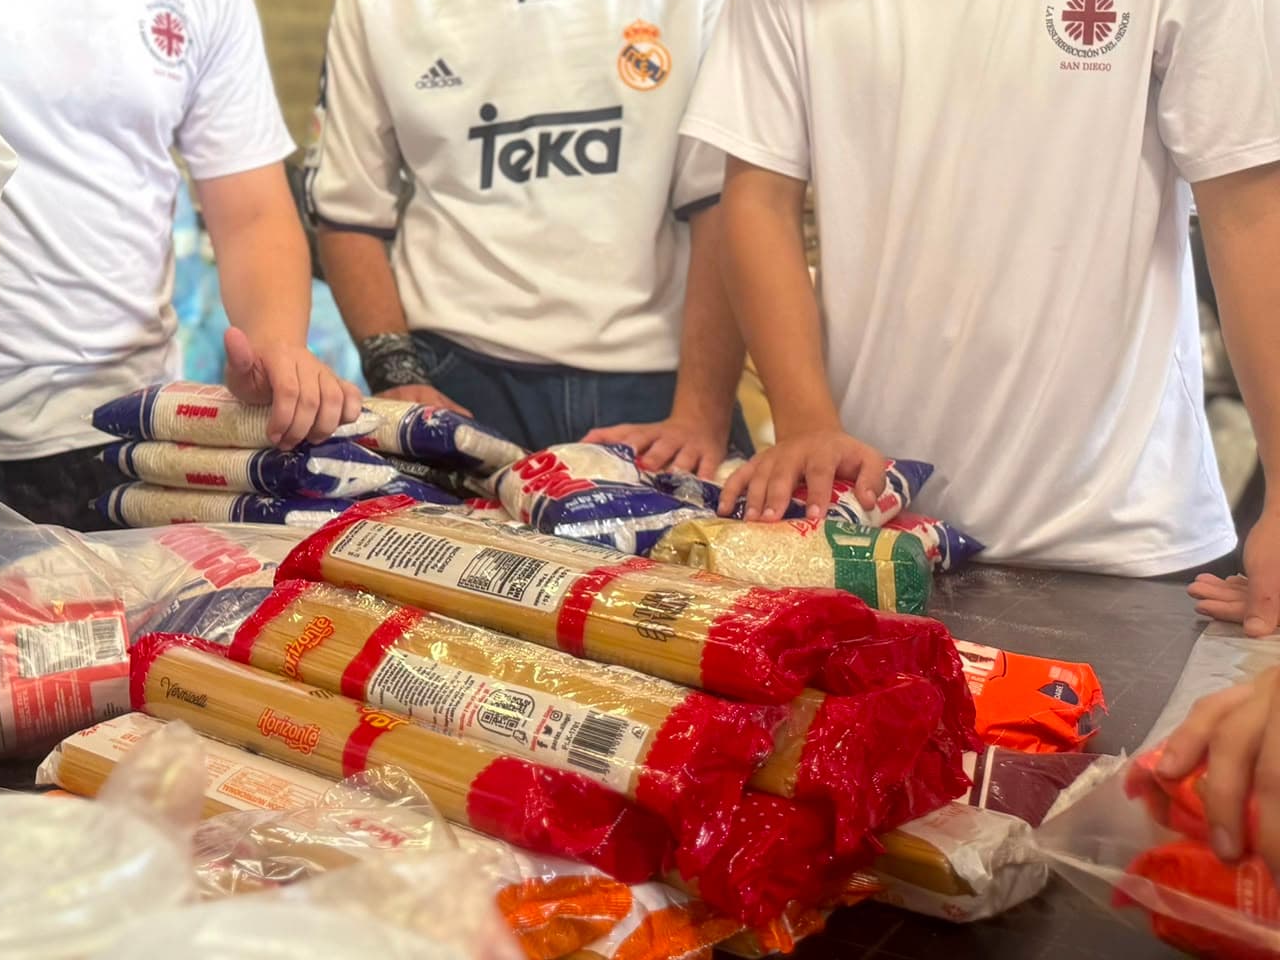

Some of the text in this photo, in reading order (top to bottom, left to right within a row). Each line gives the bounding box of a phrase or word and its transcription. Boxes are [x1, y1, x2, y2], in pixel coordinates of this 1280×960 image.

[1060, 60, 1112, 72] SAN DIEGO
[415, 76, 463, 90] adidas
[283, 615, 332, 680] orizonte
[160, 676, 208, 708] Vermicelli
[258, 707, 320, 750] Horizonte
